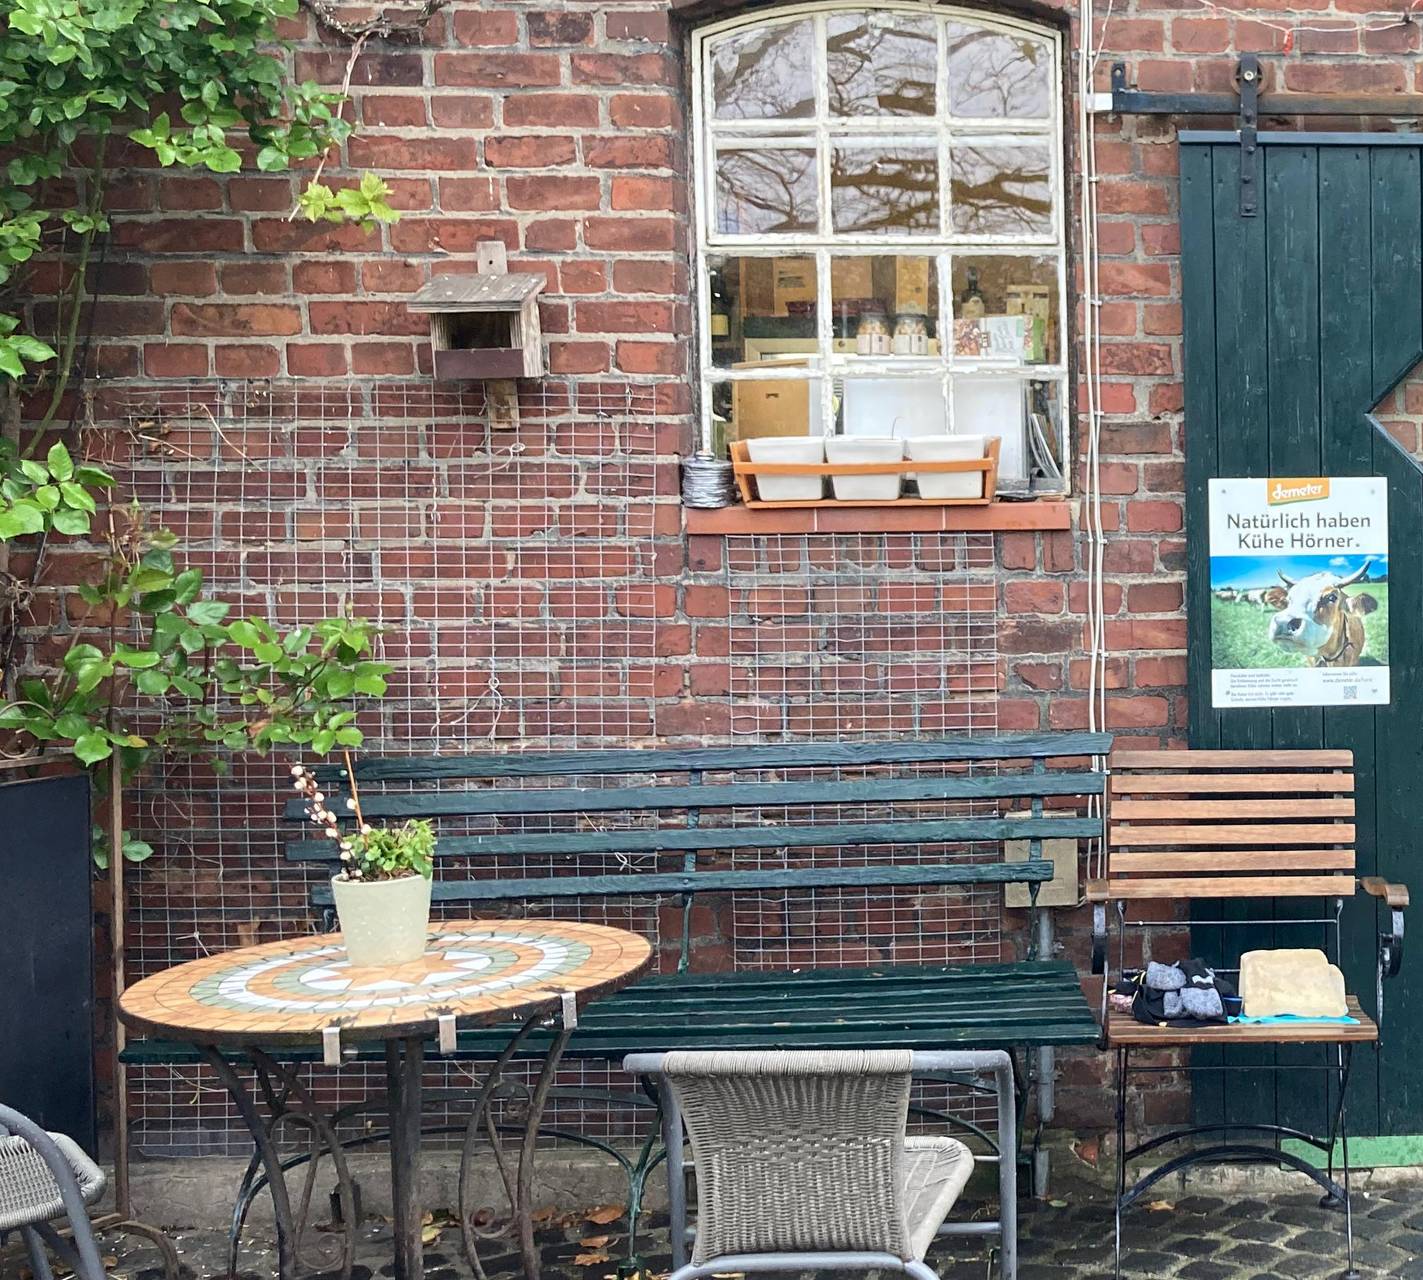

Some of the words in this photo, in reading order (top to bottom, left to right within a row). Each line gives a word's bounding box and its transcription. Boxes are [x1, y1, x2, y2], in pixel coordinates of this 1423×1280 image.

[1271, 483, 1323, 500] demeter
[1226, 512, 1310, 529] Natürlich
[1316, 512, 1371, 528] haben
[1238, 533, 1284, 549] Kühe
[1290, 533, 1361, 548] Hörner.
